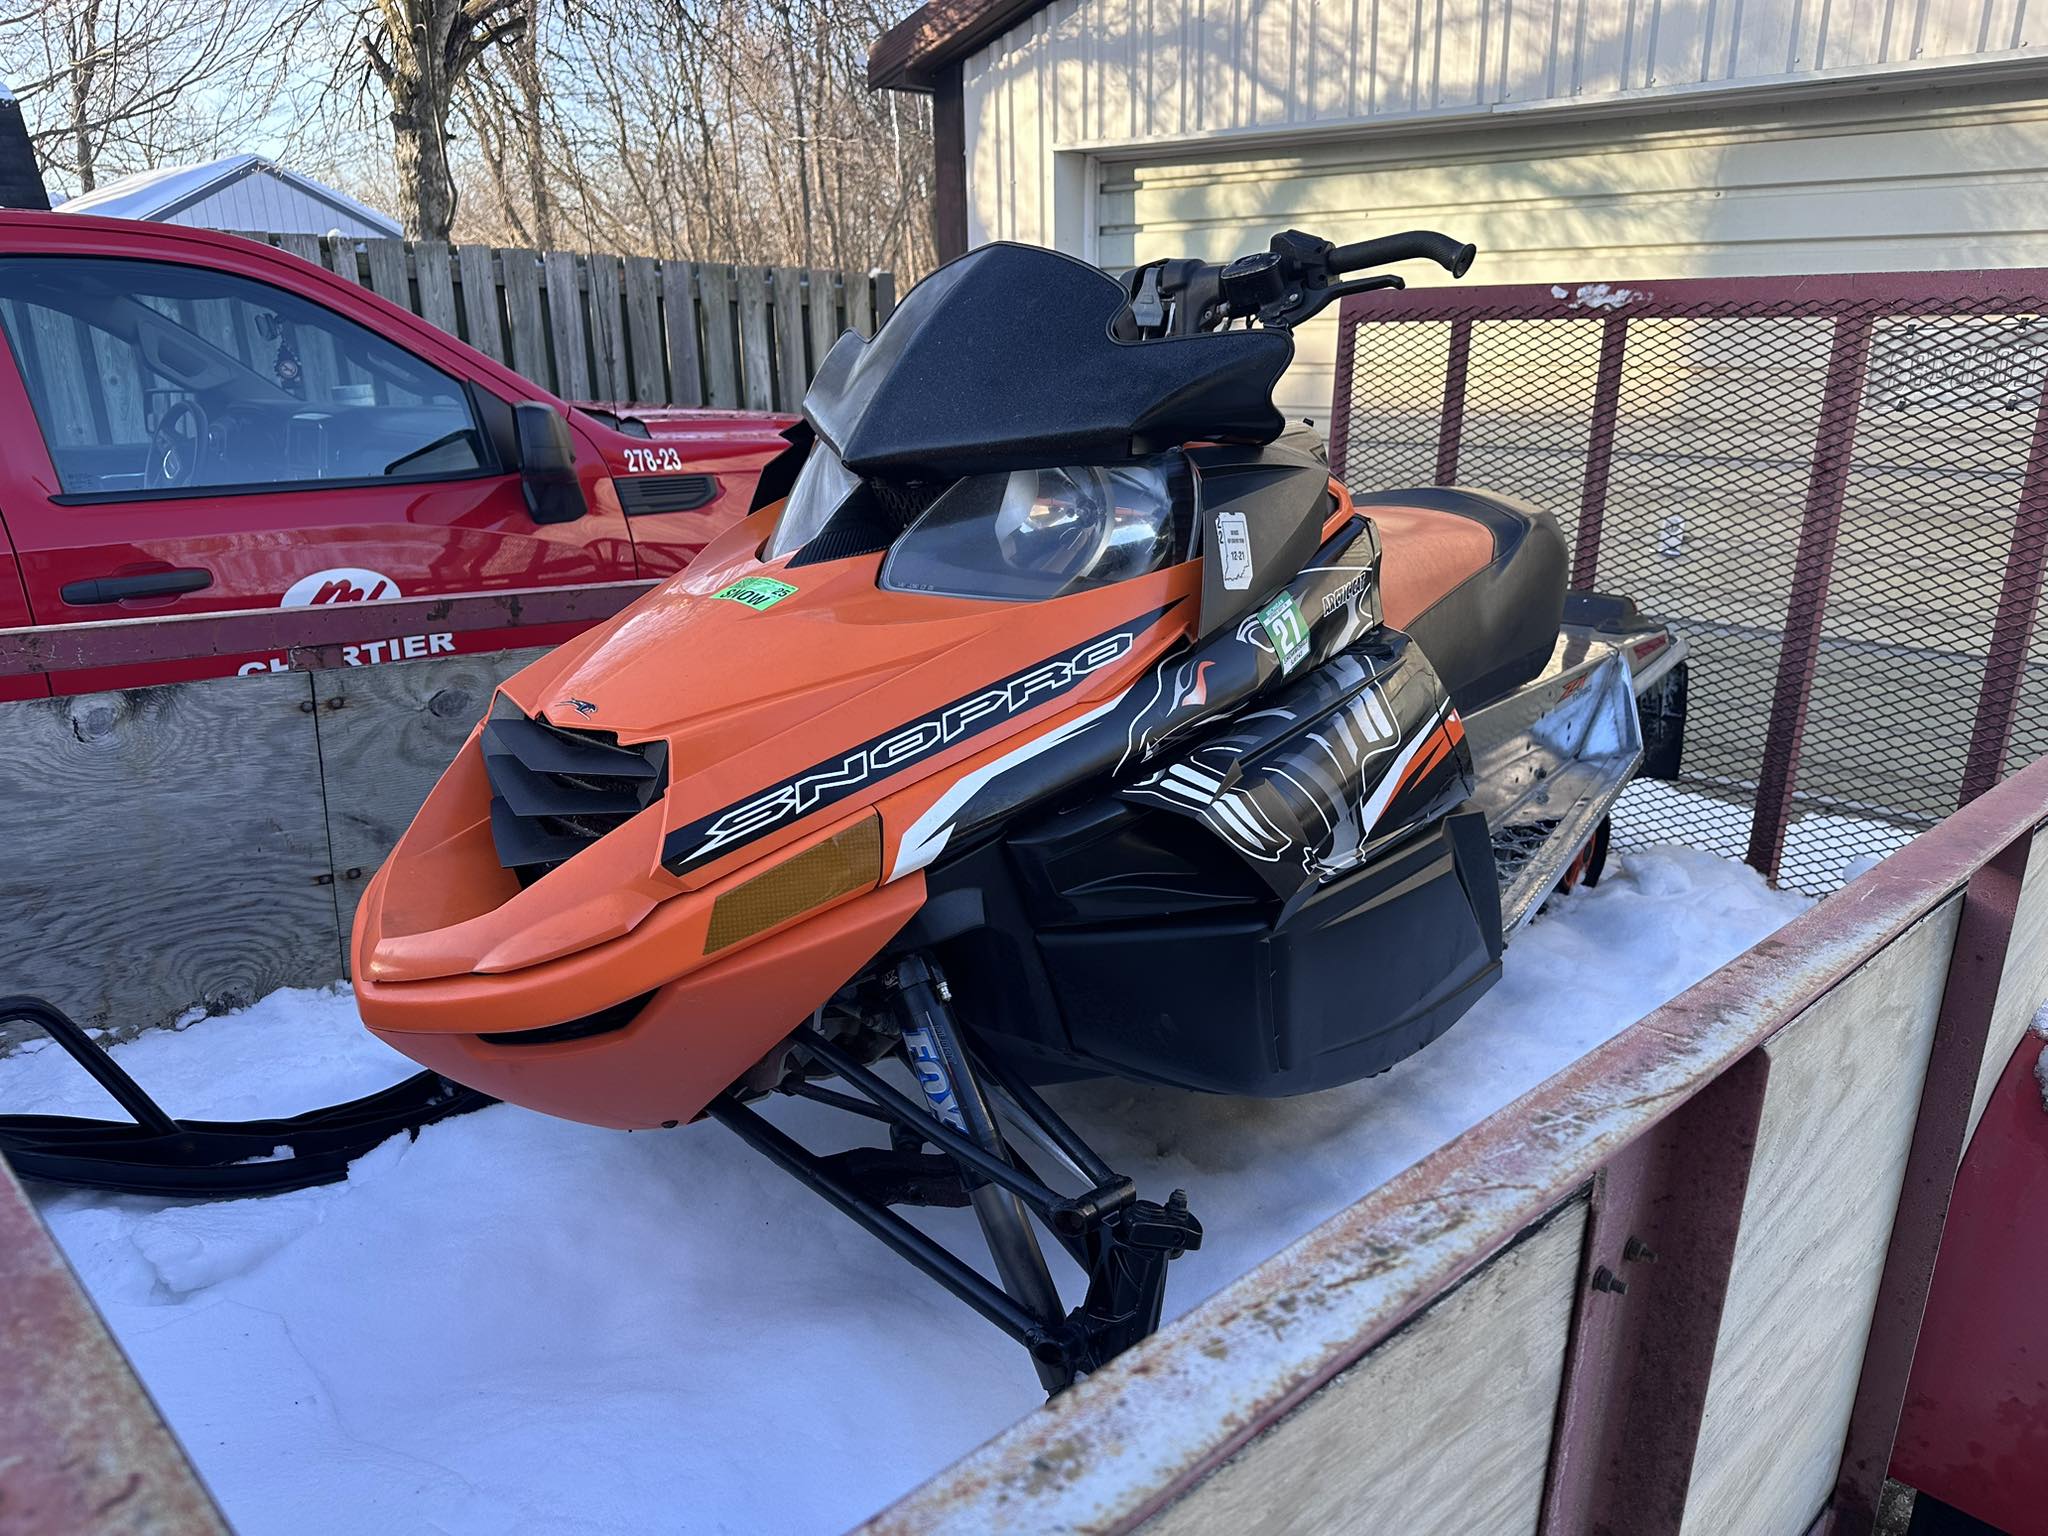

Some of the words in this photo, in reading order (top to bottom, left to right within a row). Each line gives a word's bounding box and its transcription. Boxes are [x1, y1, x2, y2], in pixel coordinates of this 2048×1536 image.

[624, 448, 682, 472] 278-23
[720, 589, 771, 606] SNOW
[771, 583, 792, 597] 25
[1322, 581, 1352, 618] ARCTIC
[1272, 608, 1302, 656] 27
[680, 632, 1133, 866] SNOPRO
[902, 1027, 970, 1135] FOX
